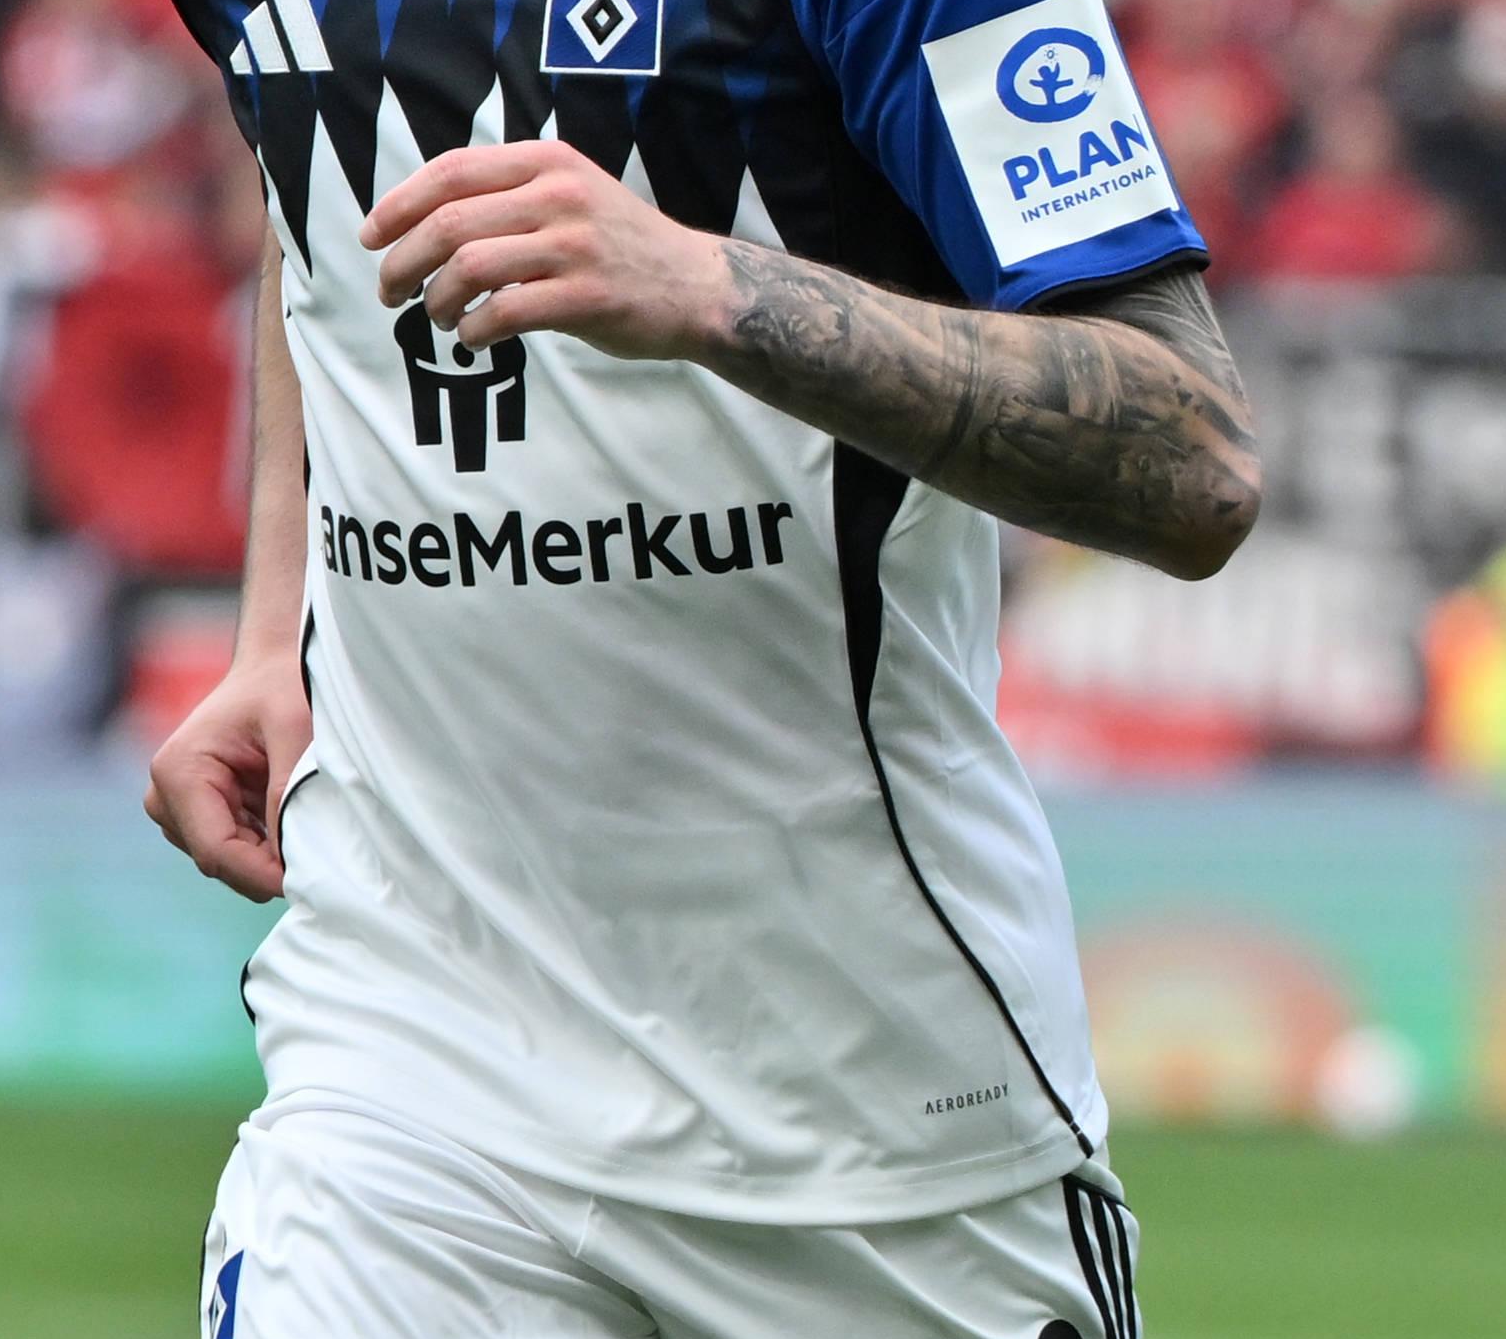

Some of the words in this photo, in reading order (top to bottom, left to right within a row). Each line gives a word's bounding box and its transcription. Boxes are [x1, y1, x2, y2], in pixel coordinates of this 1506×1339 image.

[1002, 114, 1149, 200] PLAN
[1021, 165, 1156, 223] INTERNATIONA
[321, 502, 793, 588] anseMerkur
[925, 1083, 1008, 1115] AEROREADY
